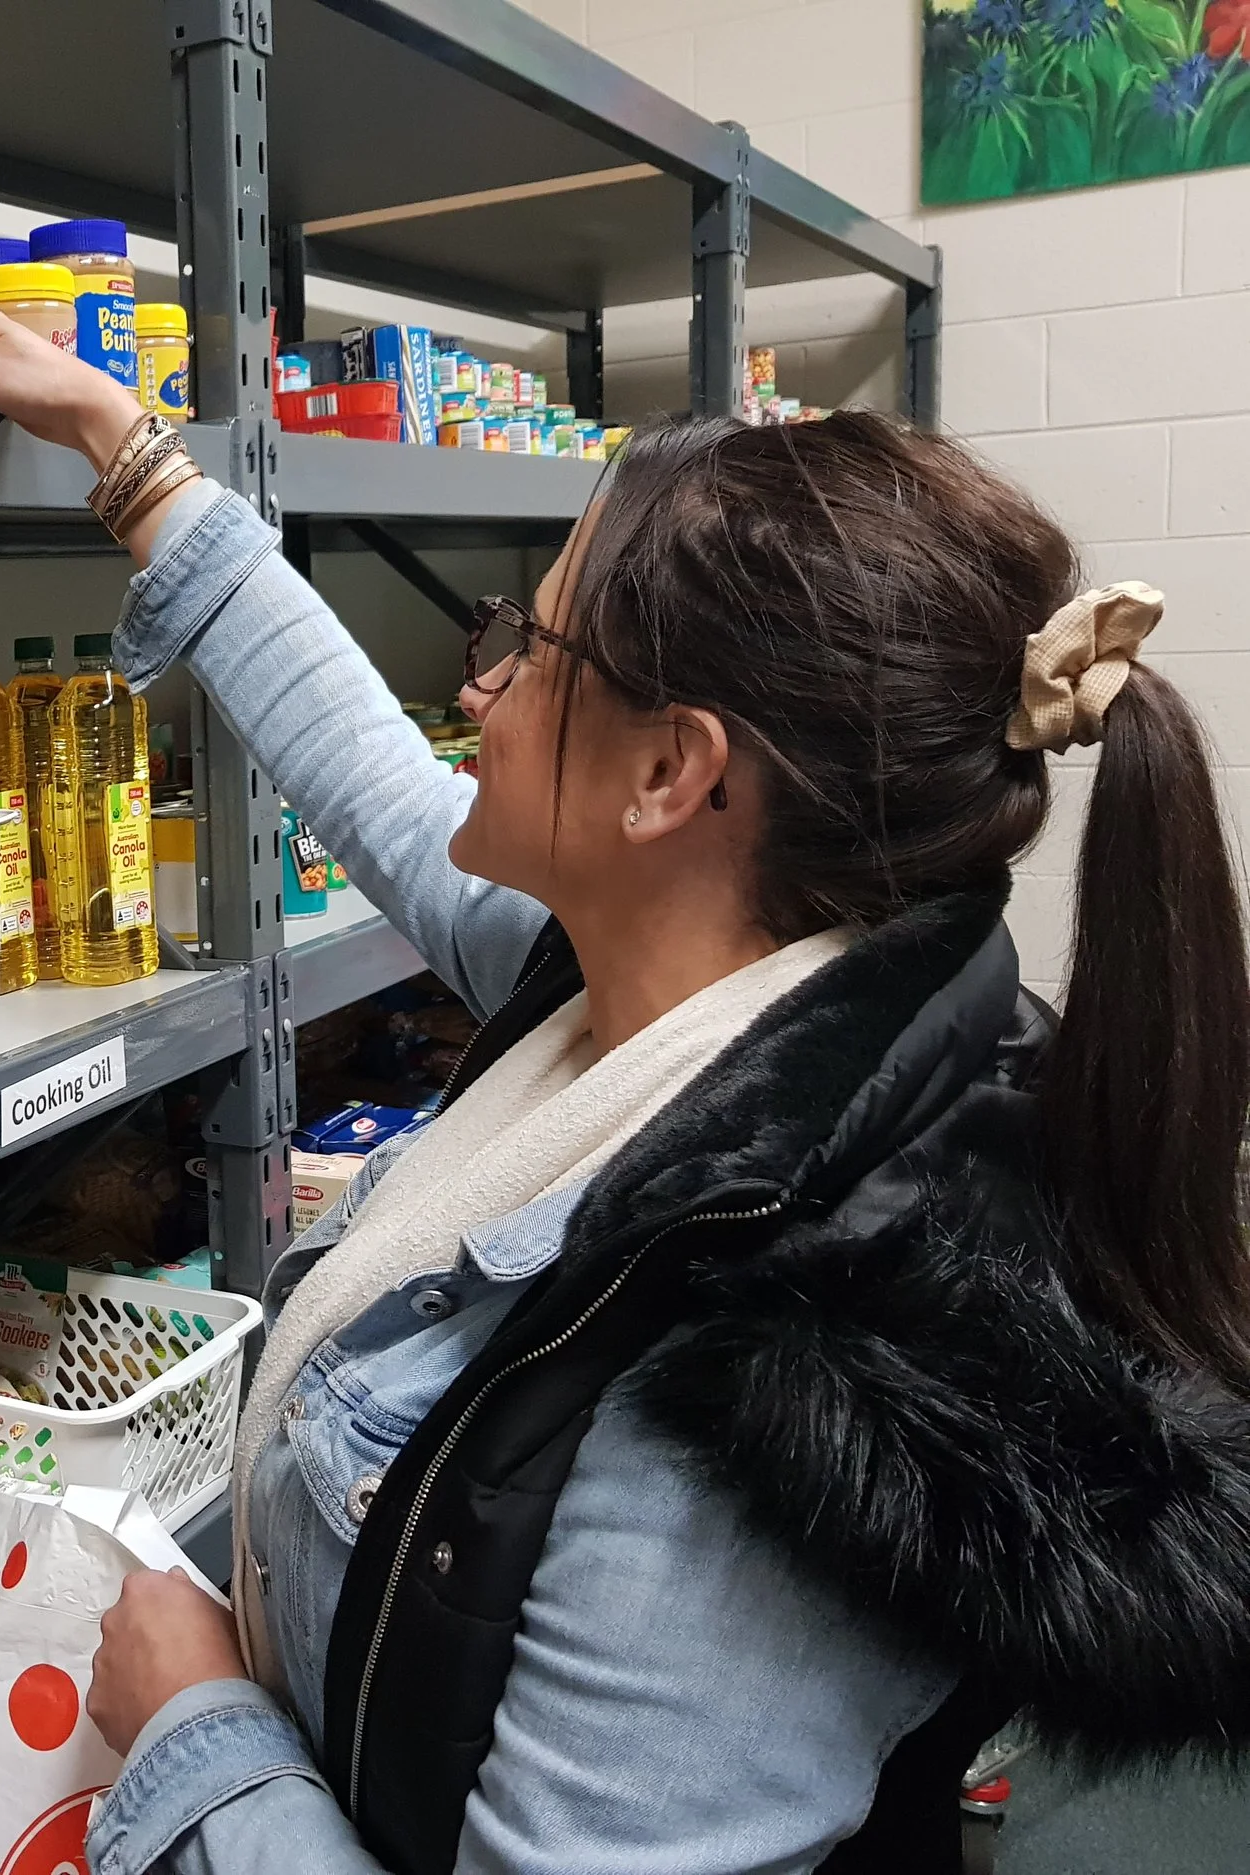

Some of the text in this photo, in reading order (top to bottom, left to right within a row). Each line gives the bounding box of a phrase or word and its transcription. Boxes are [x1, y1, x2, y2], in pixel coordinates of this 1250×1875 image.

[410, 332, 433, 443] SARDINES
[112, 840, 146, 856] Canola
[122, 855, 136, 868] Oil
[5, 863, 19, 877] Oil
[10, 1056, 113, 1128] Cooking Oil
[292, 1186, 323, 1199] Barilla
